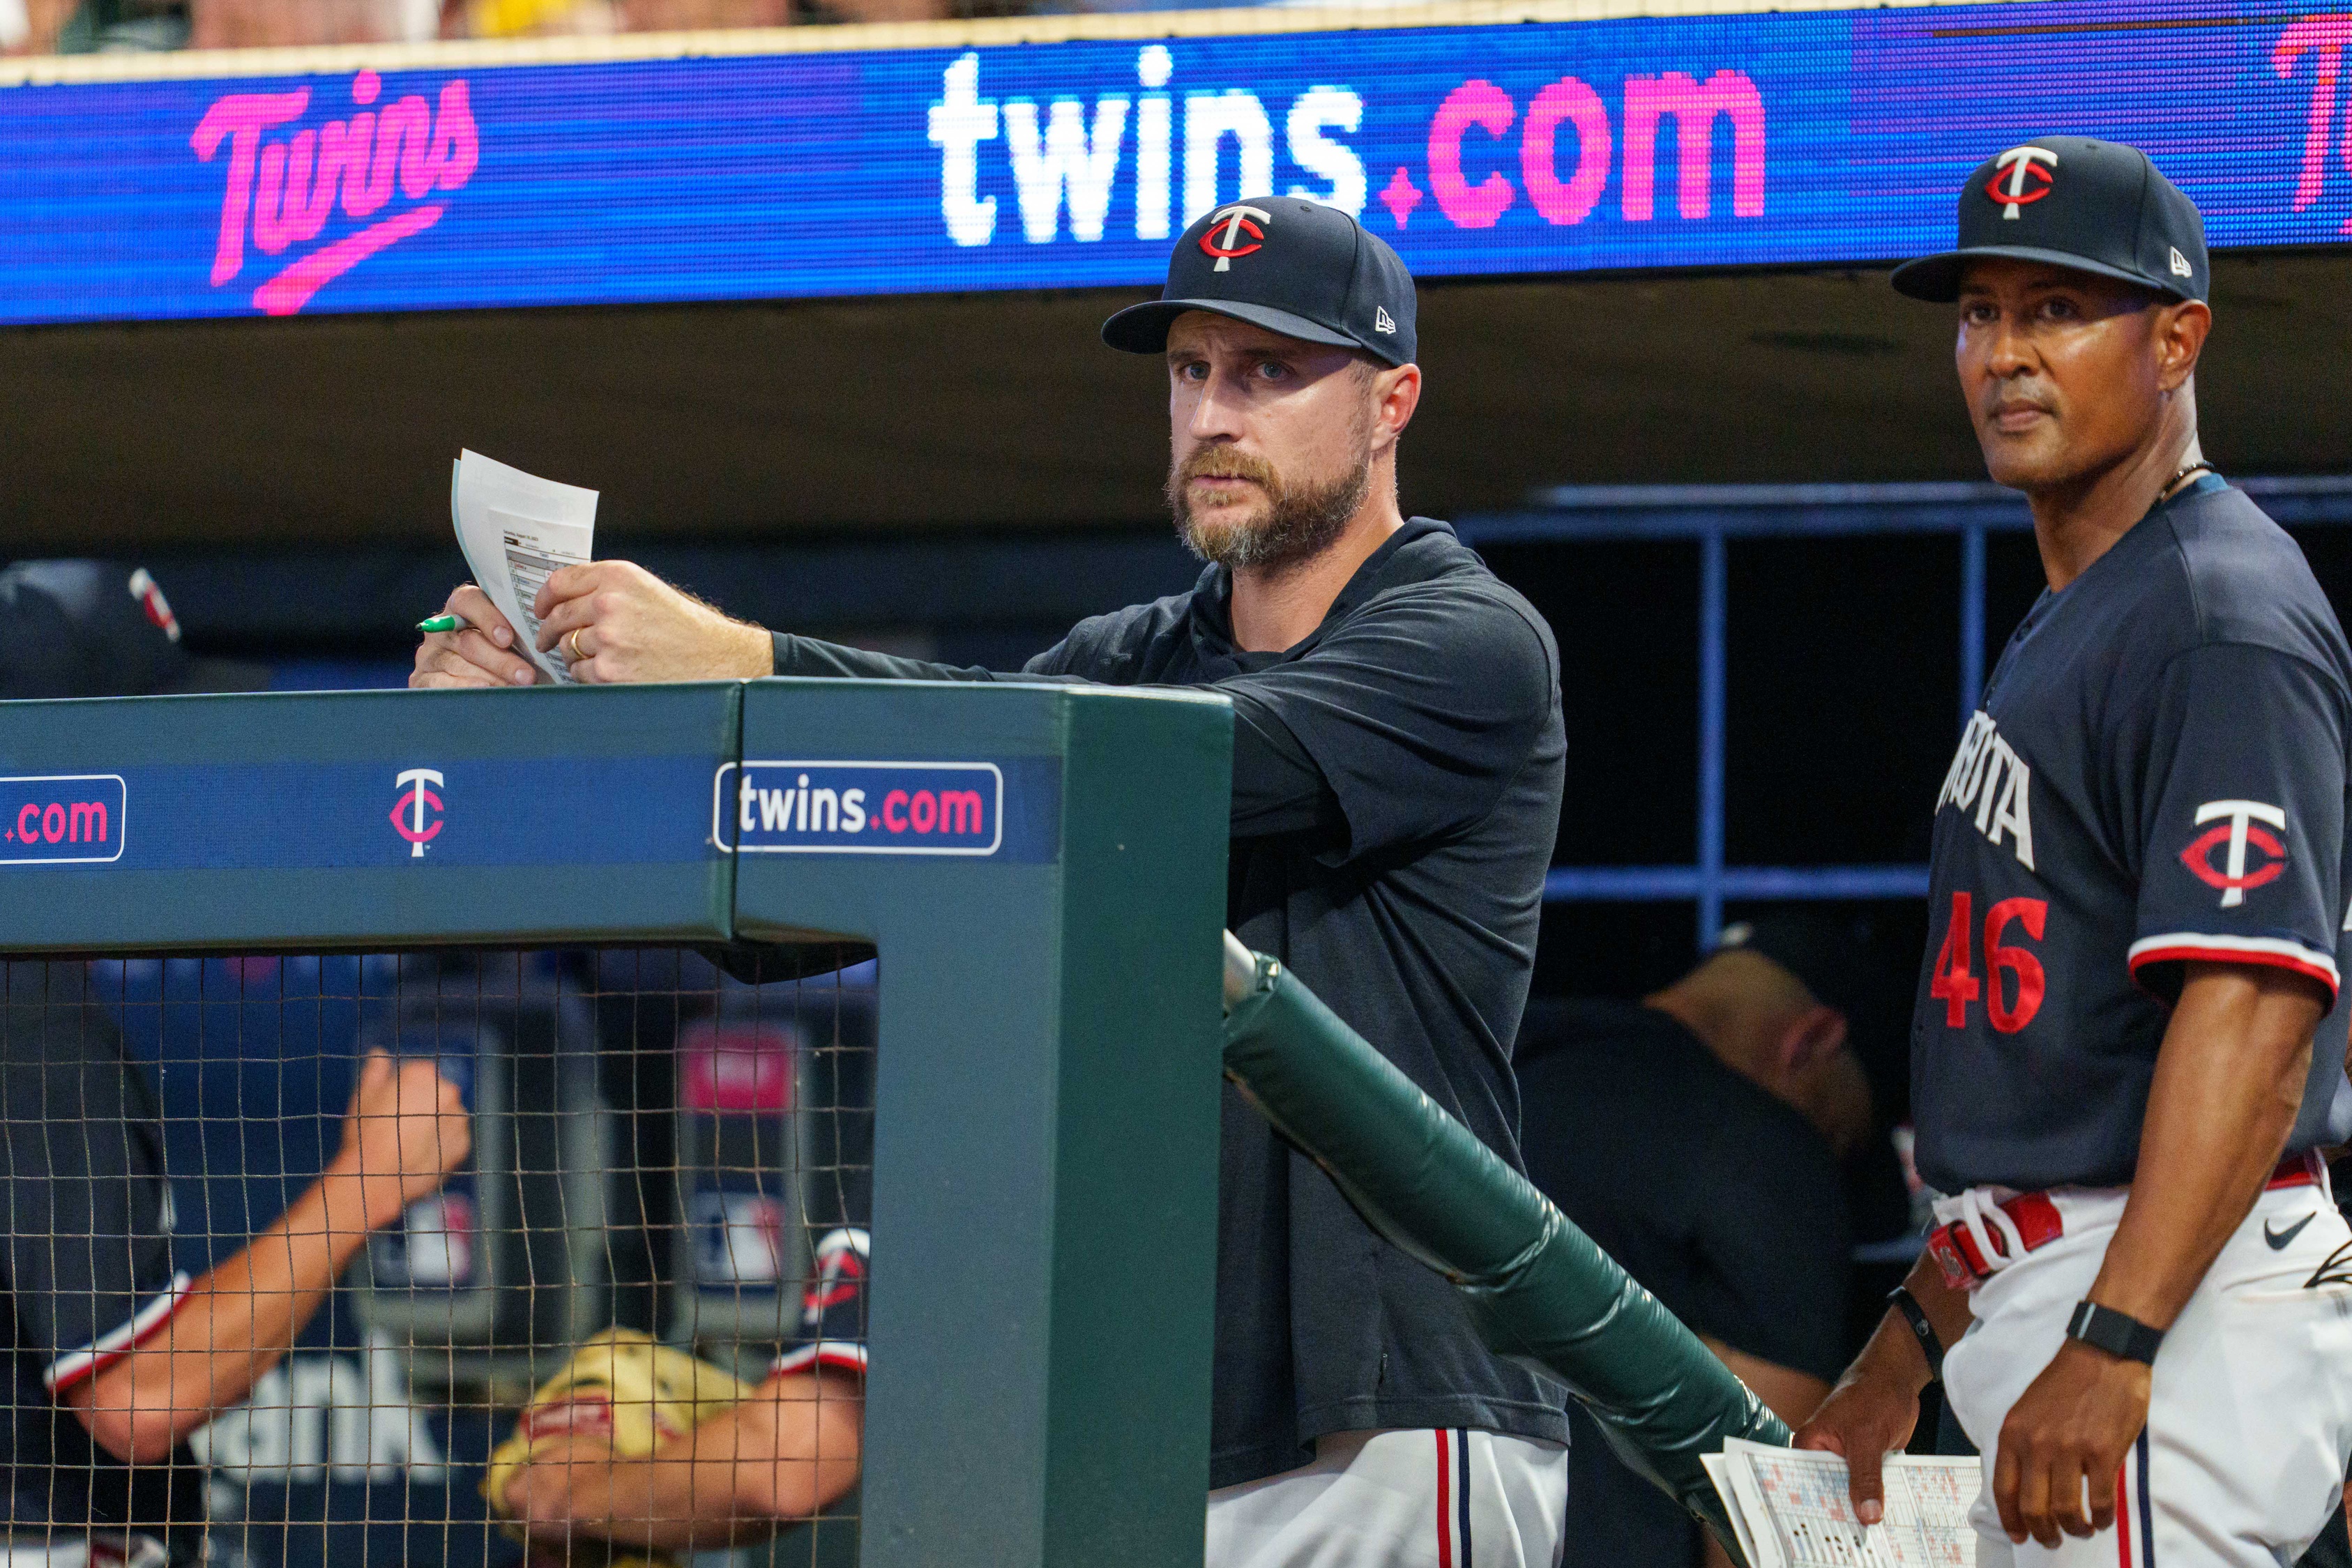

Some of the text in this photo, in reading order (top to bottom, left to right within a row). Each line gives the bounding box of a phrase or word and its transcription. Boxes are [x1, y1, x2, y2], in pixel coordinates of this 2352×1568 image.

[190, 69, 478, 287] Twins
[929, 45, 1765, 247] twins.com
[739, 773, 983, 835] twins.com
[1930, 891, 2049, 1034] 46
[187, 1328, 451, 1485] ank
